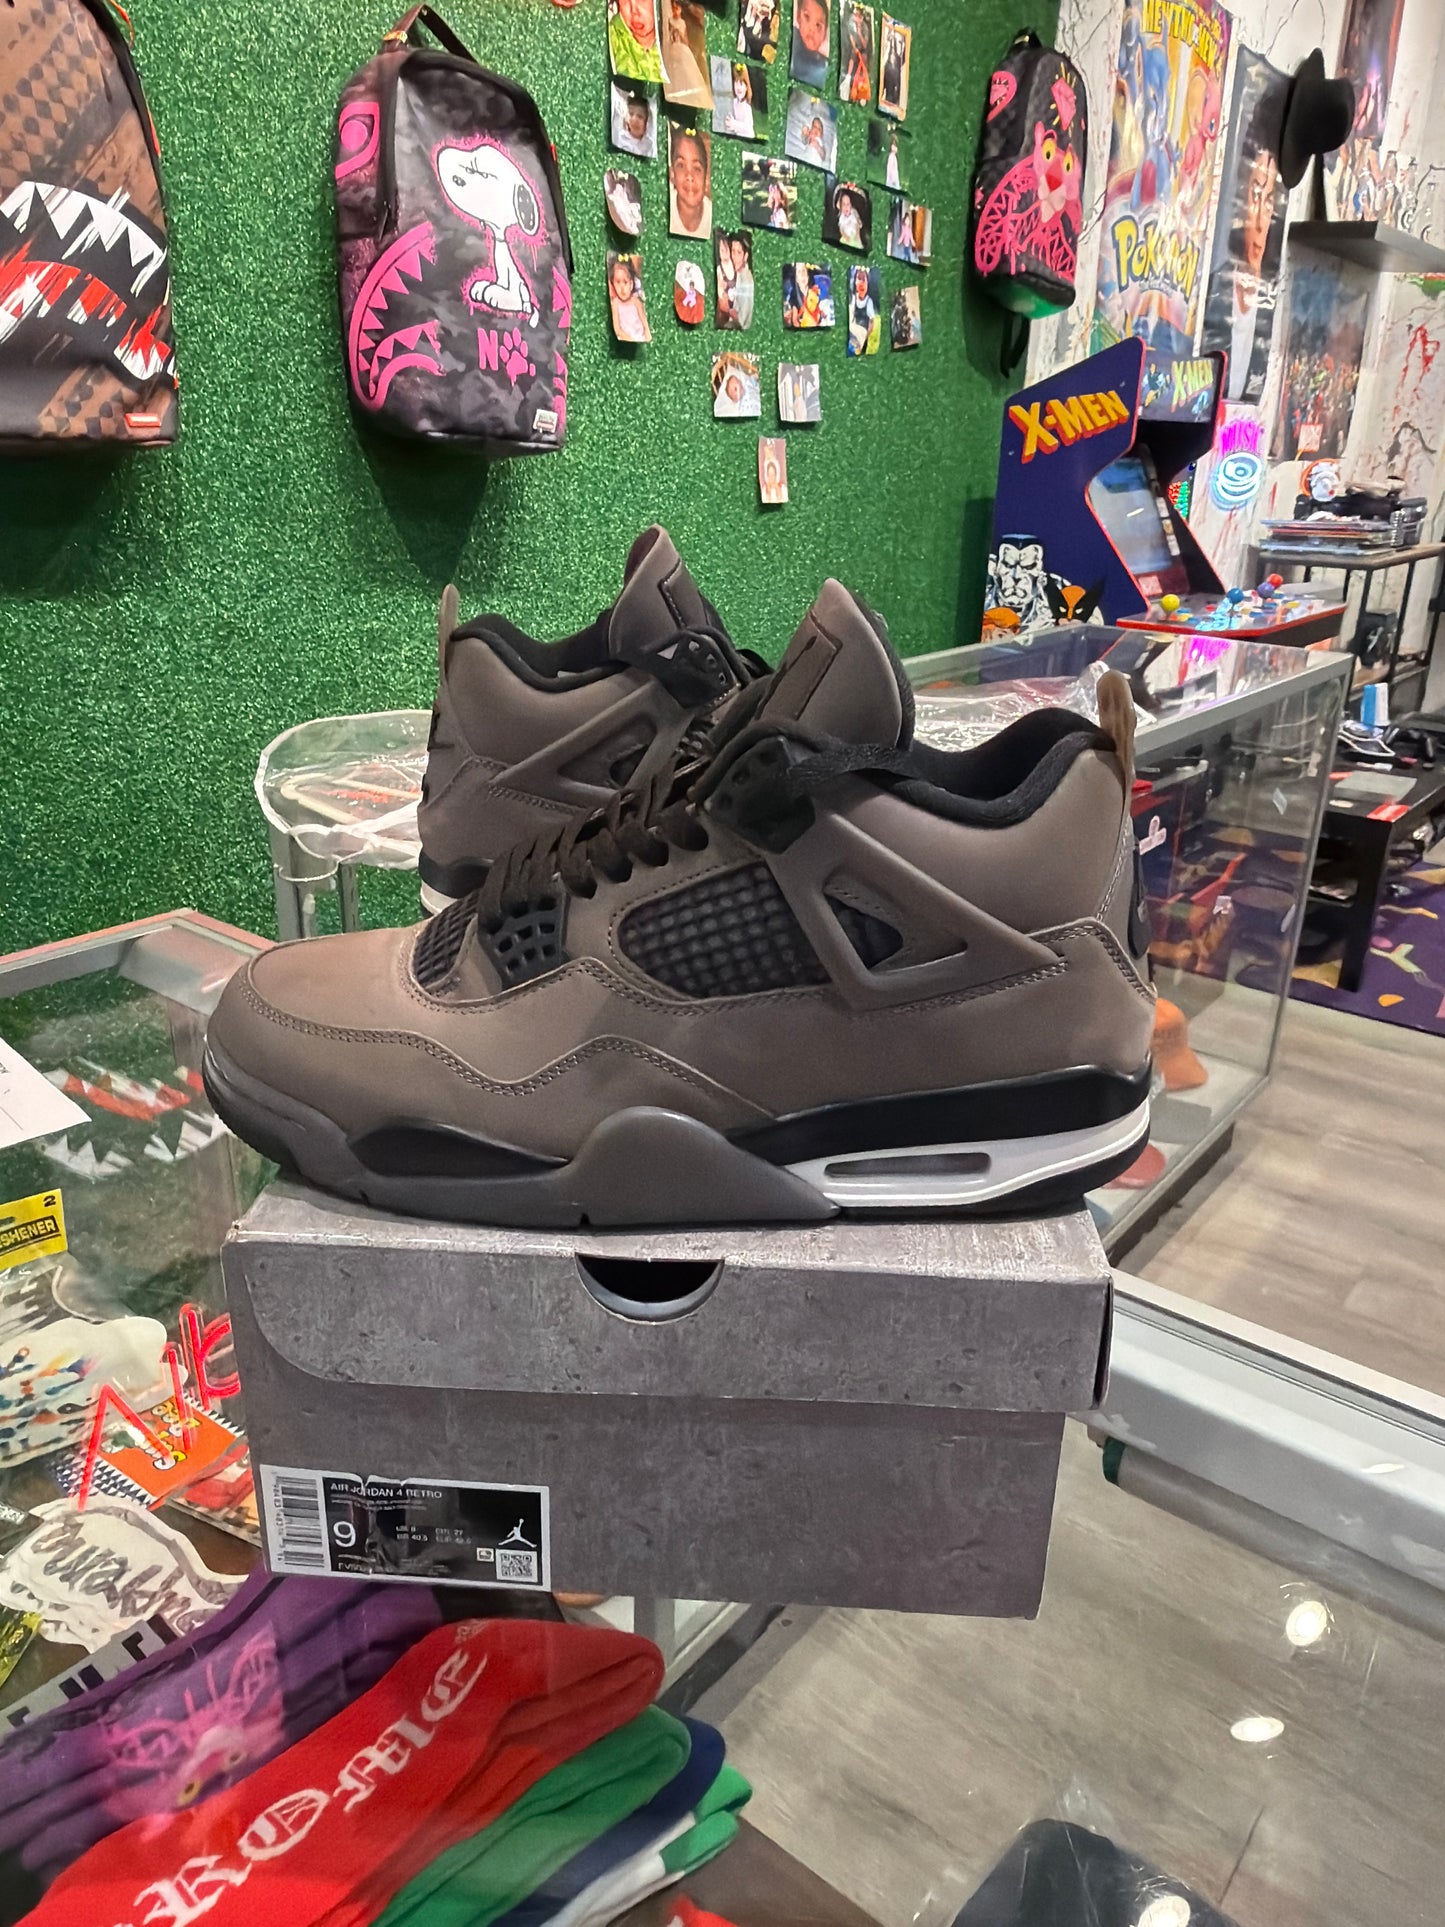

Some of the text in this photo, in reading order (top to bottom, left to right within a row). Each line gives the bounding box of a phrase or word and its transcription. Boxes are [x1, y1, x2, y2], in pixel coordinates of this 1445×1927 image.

[1171, 360, 1213, 411] X-MEN
[1008, 390, 1130, 464] X-MEN
[43, 1195, 56, 1207] 2
[330, 1482, 443, 1499] AIR JORDAN 4 RETRO
[333, 1521, 357, 1548] 9
[112, 1649, 488, 1927] ROME
